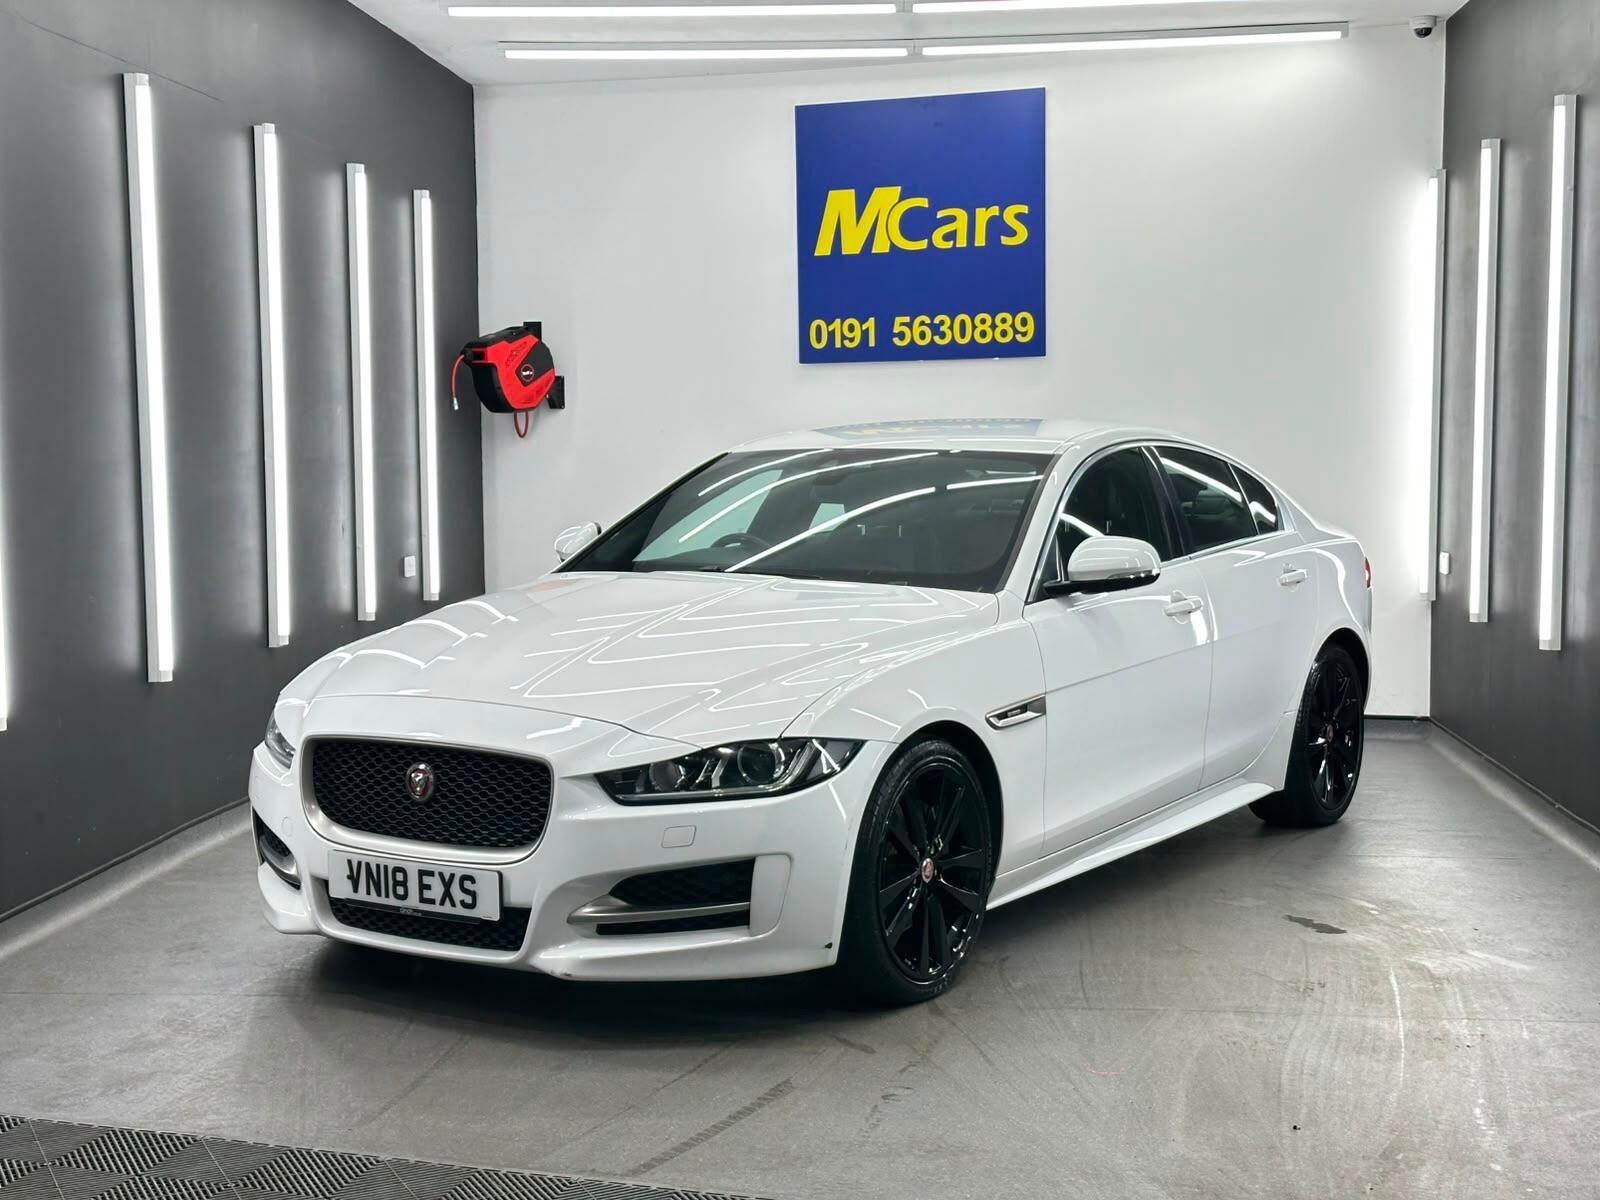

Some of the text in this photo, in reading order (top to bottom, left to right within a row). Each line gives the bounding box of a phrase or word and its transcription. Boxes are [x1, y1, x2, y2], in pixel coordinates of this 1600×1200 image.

[814, 186, 1029, 257] MCars
[809, 311, 1035, 349] 0191 5630889
[346, 858, 478, 910] VN18 EXS
